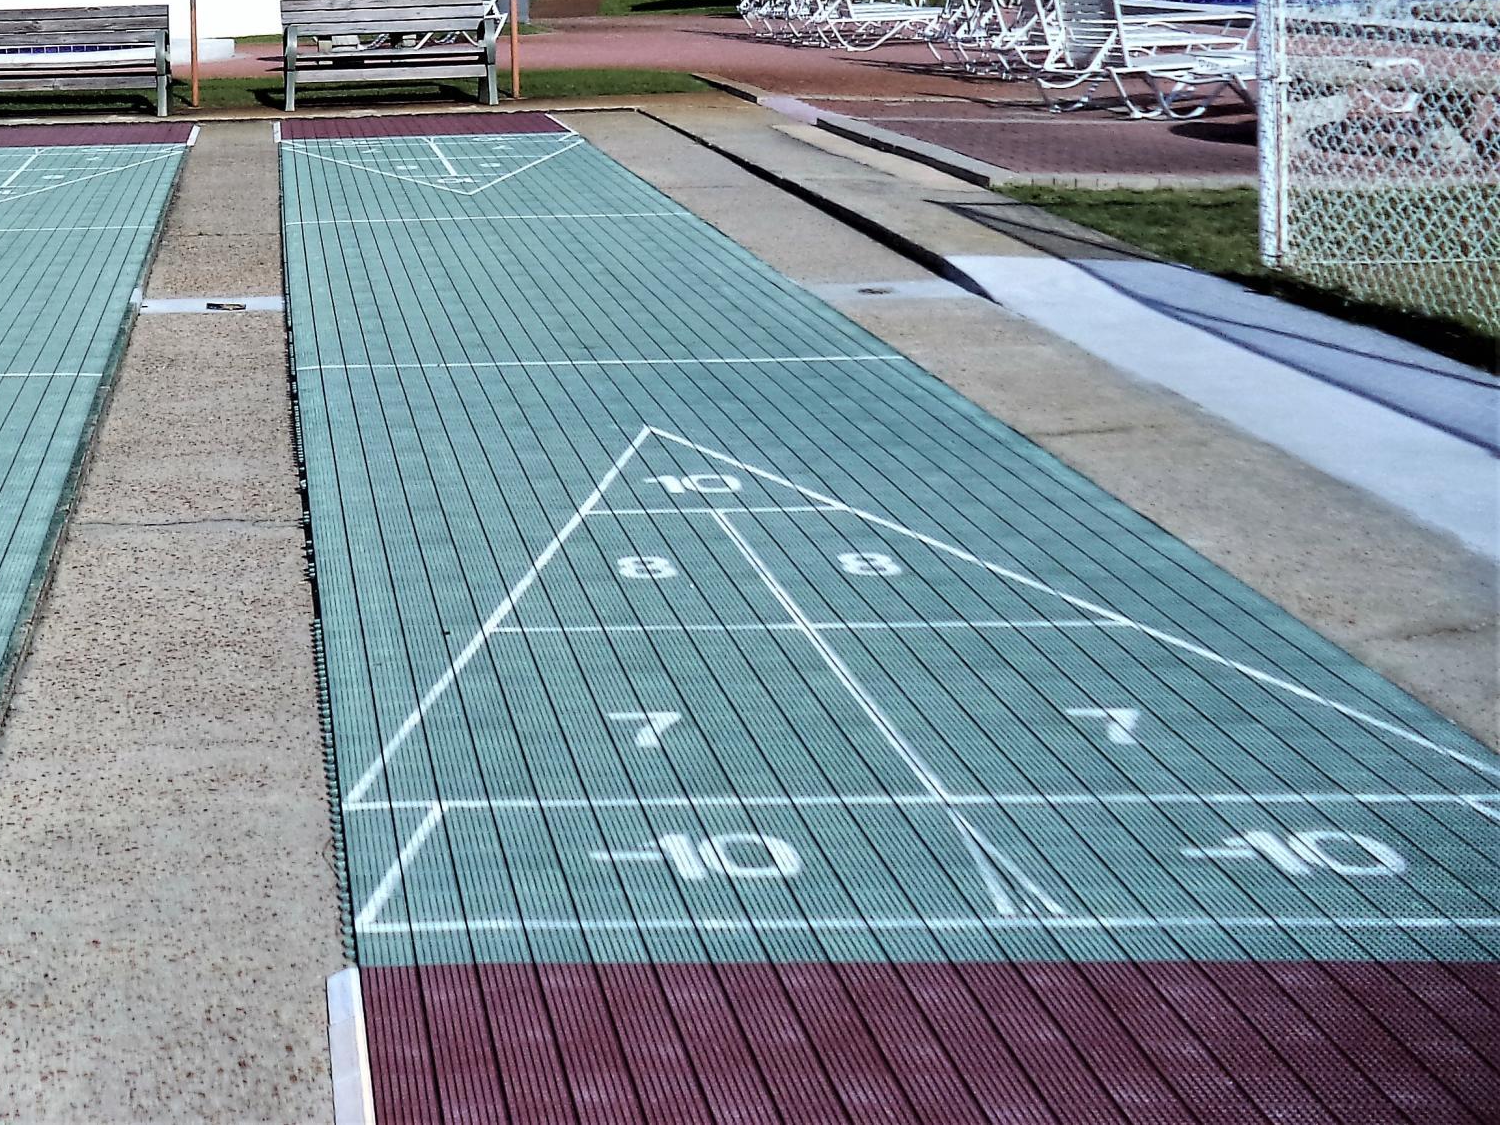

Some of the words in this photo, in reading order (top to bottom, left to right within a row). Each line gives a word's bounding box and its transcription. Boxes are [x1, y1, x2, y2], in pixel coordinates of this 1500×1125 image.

[642, 474, 742, 495] 10
[617, 556, 678, 580] 8
[836, 551, 902, 576] 8
[607, 711, 682, 748] 7
[1064, 705, 1140, 745] 7
